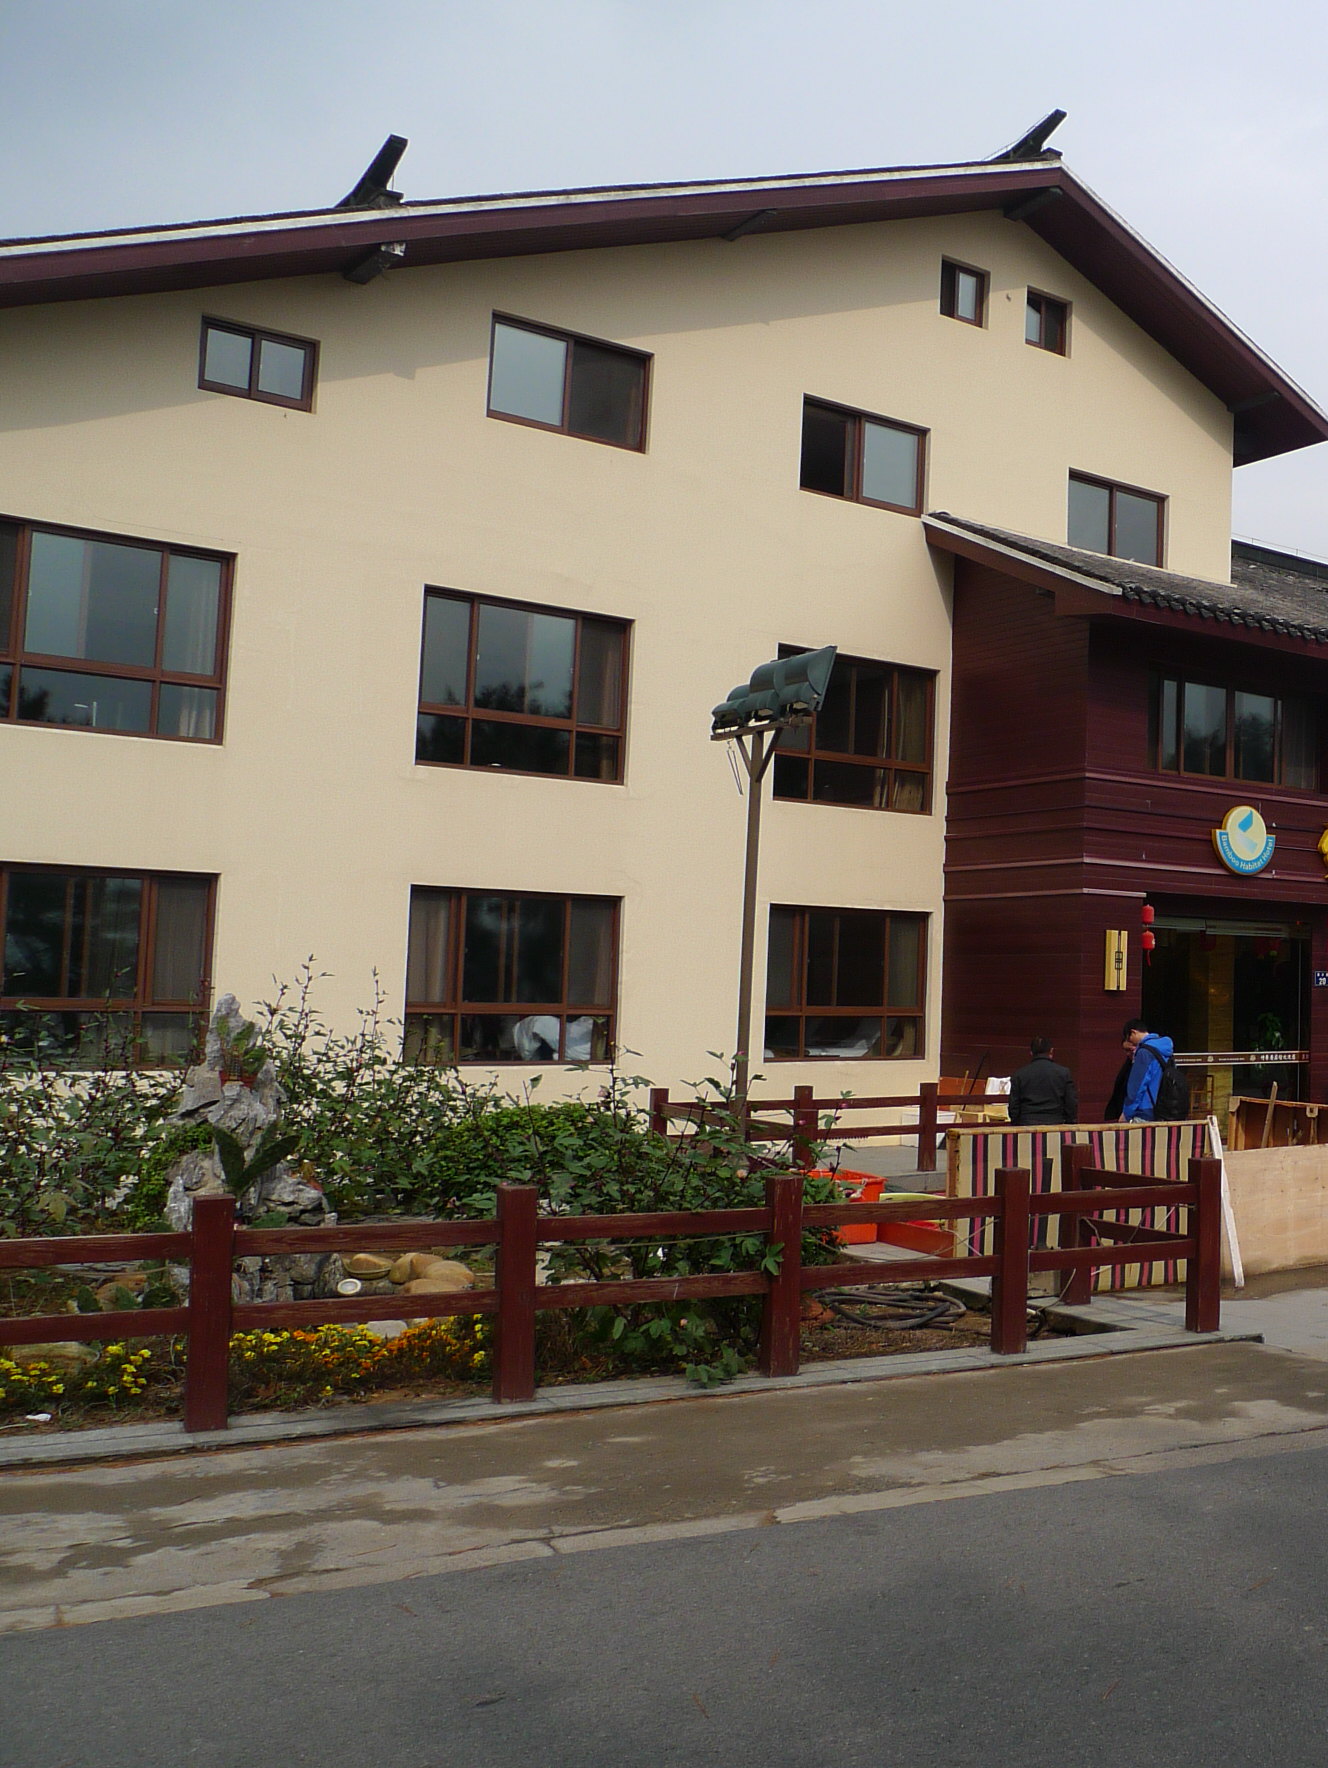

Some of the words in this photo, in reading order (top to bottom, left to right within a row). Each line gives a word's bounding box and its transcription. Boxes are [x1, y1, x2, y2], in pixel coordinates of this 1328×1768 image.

[1221, 834, 1240, 866] Bamboo
[1239, 858, 1264, 870] Habitat
[1261, 838, 1274, 860] Hotel
